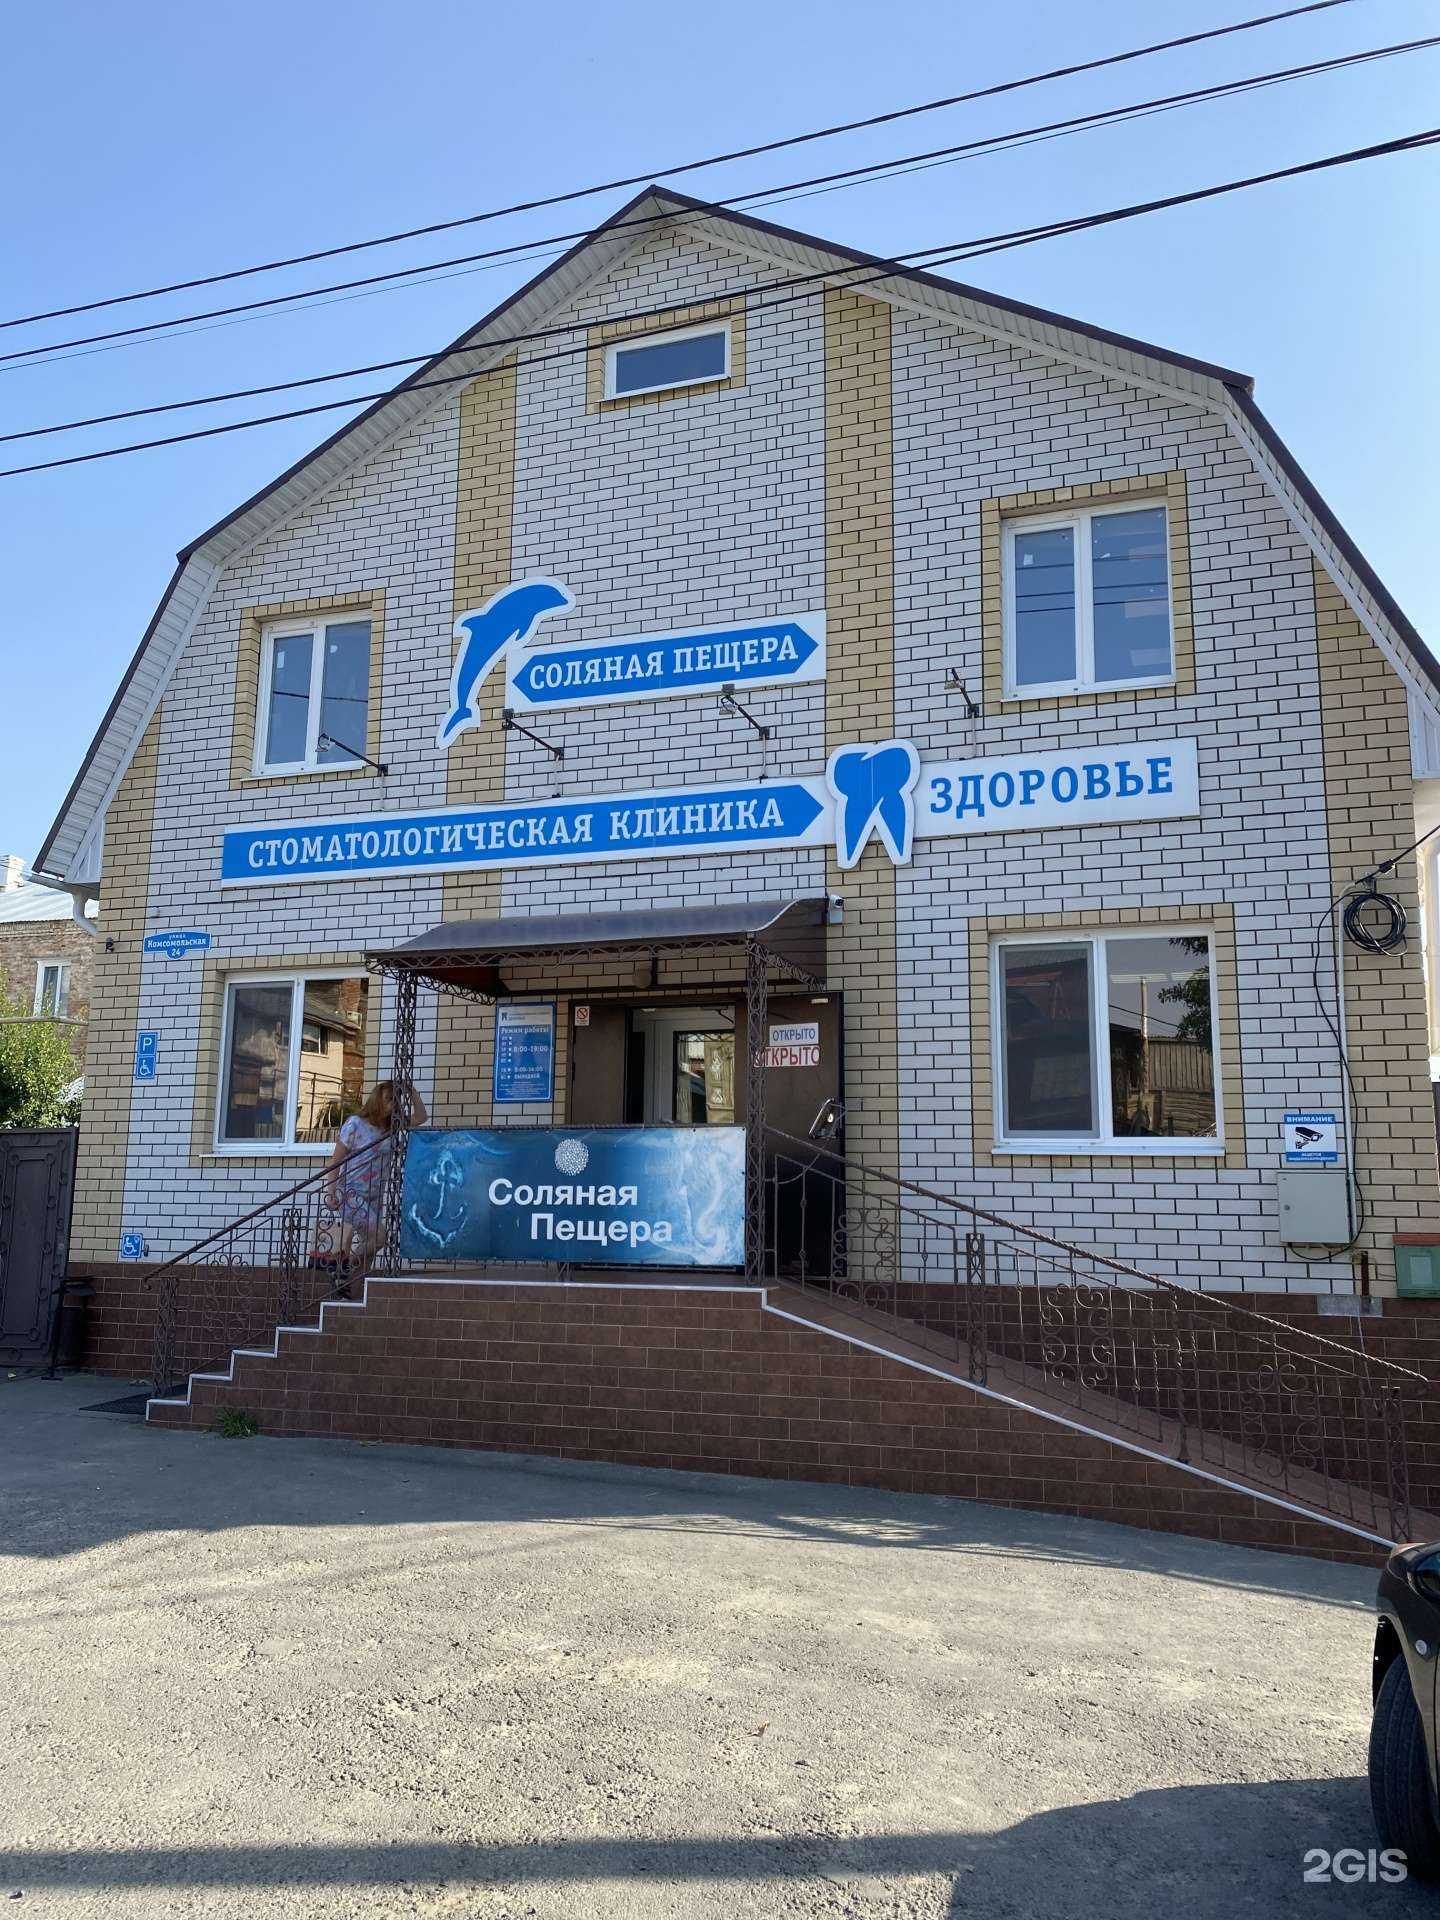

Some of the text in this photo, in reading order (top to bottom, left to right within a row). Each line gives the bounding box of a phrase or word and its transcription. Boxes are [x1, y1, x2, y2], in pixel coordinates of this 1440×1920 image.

[529, 634, 799, 690] СОЛЯНАЯ ПЕЩЕРА
[930, 757, 1173, 819] ЗДОРОВЬЕ
[248, 798, 784, 869] СТОМАТОЛОГИЧЕСКАЯ КЛИНИКА
[147, 939, 206, 948] Комсомольская
[171, 949, 180, 957] 24
[772, 1028, 816, 1042] ОТКРЫТО
[488, 1178, 638, 1206] Соляная
[530, 1213, 673, 1248] Пещера
